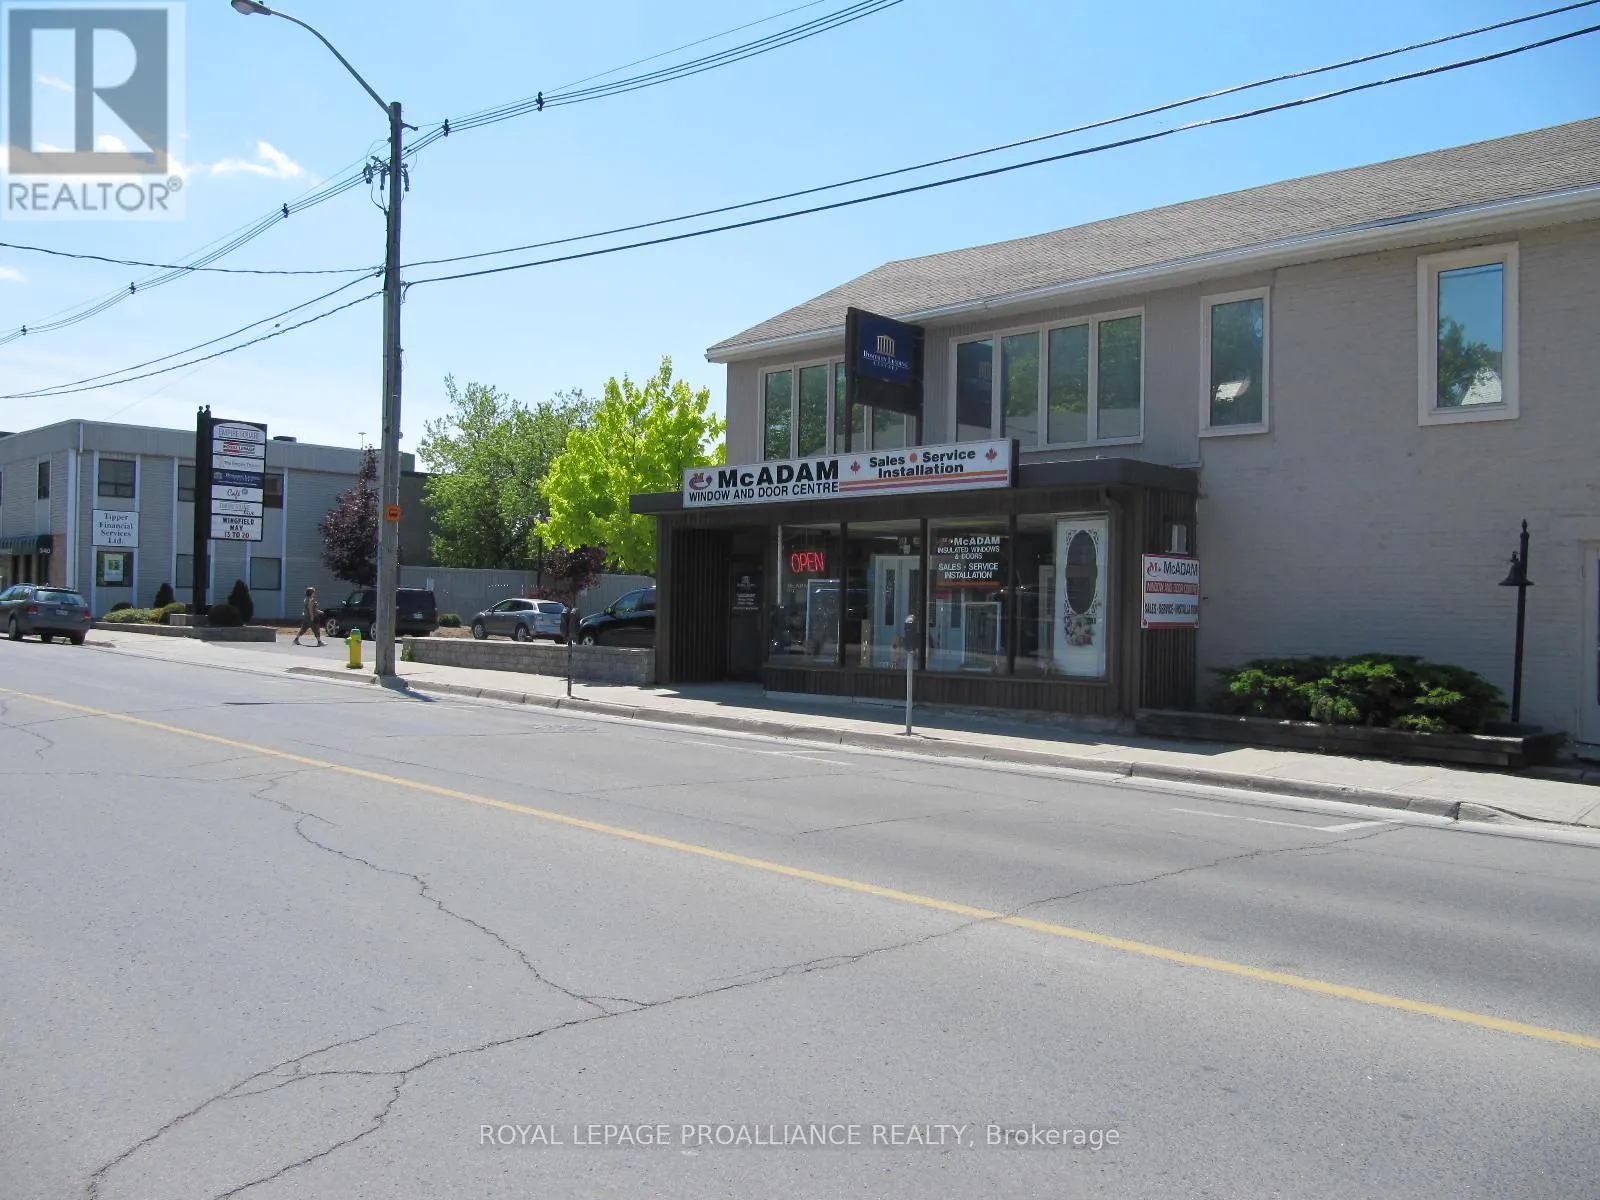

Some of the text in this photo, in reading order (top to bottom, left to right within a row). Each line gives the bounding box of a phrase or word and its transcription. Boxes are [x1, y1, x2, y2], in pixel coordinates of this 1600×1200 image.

[869, 449, 976, 468] Sales Service
[718, 459, 839, 488] McADAM
[878, 462, 964, 478] Installation
[689, 481, 839, 502] WINDOW AND DOOR CENTRE
[104, 512, 128, 521] Tipper
[99, 521, 133, 530] Financial
[223, 517, 254, 526] WINGFIELD
[100, 529, 131, 537] Services
[954, 536, 1000, 546] McADAM
[937, 545, 1000, 554] INSULATED WINDOWS
[791, 551, 825, 573] OPEN
[938, 562, 999, 571] SALES SERVICE
[1163, 561, 1198, 577] McADAM
[944, 571, 992, 579] INSTALLATION
